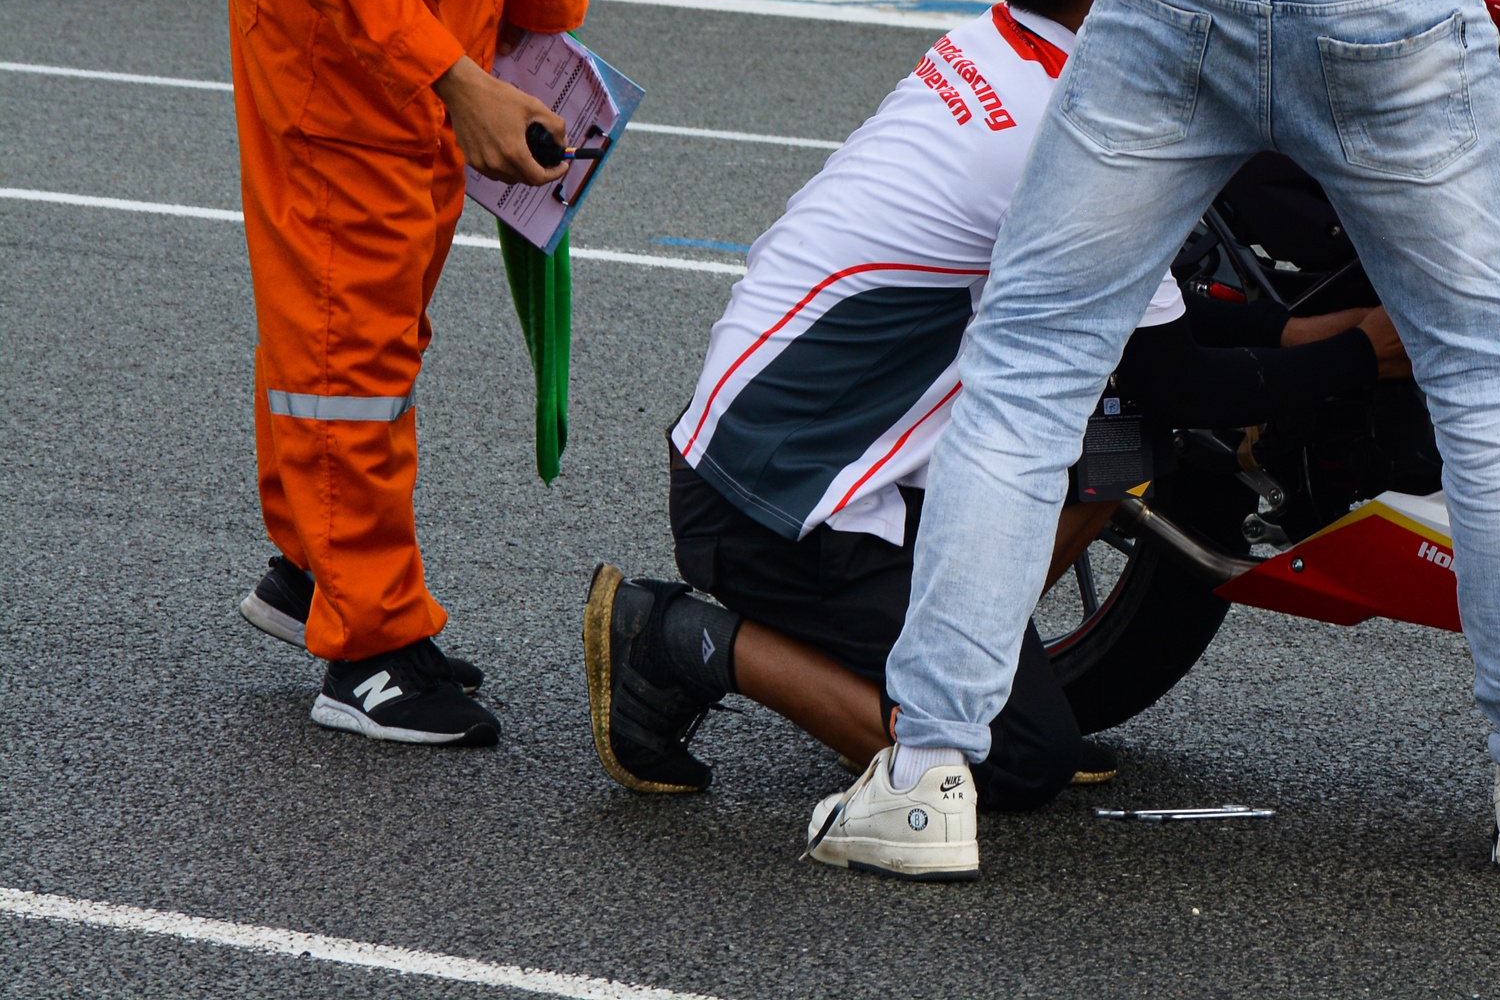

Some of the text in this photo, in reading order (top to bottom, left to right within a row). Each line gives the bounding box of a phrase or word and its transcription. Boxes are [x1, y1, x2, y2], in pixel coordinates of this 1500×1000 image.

[952, 59, 1017, 131] Racing
[353, 670, 402, 712] N
[944, 775, 962, 786] NIKE
[943, 792, 964, 800] AIR
